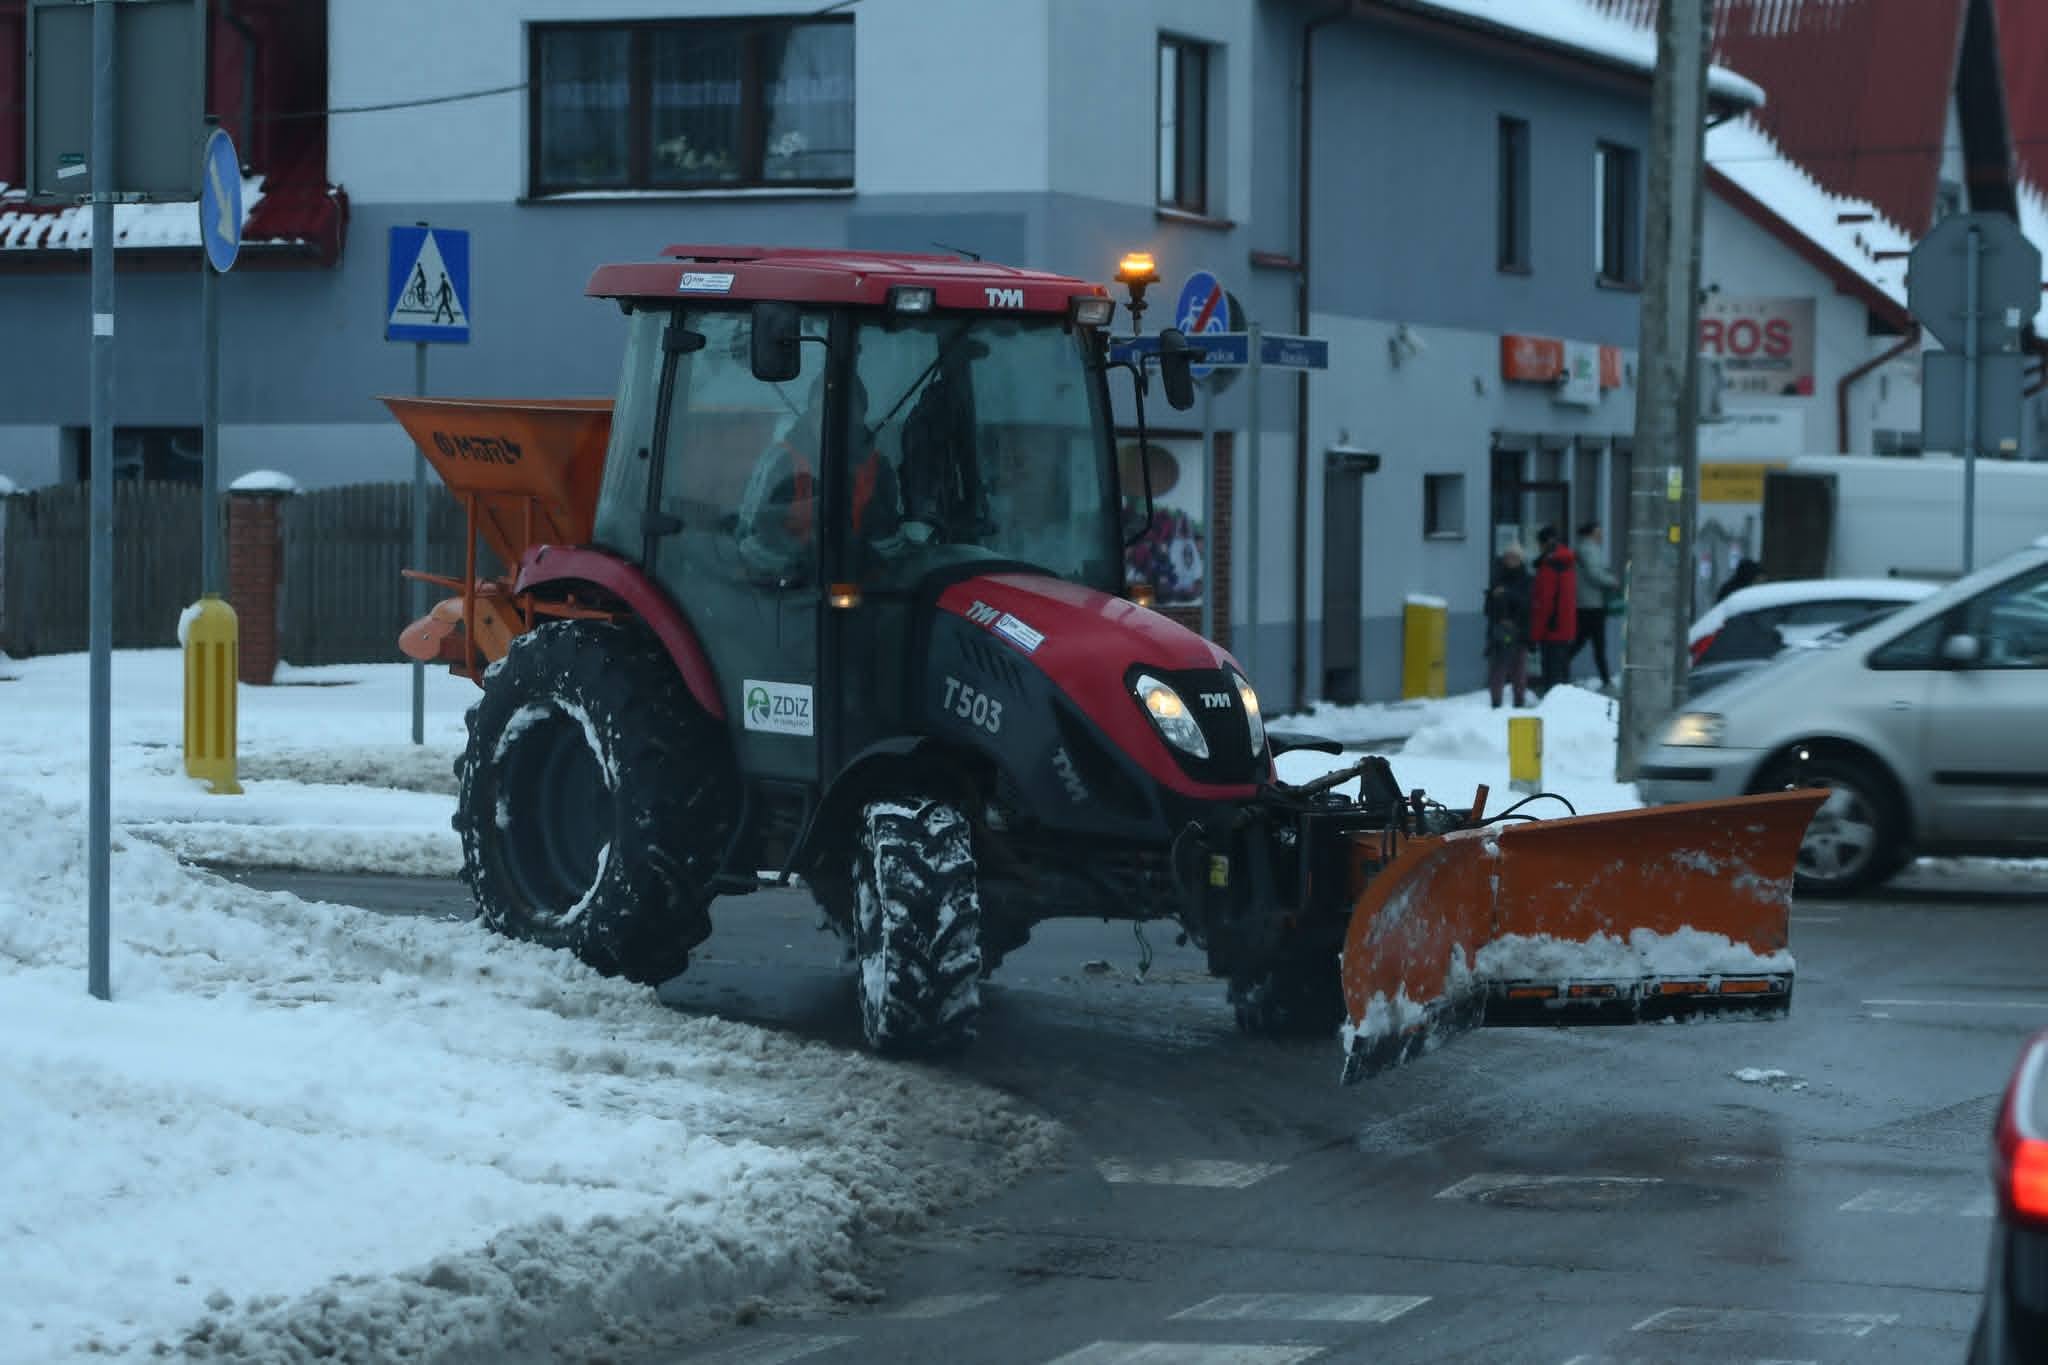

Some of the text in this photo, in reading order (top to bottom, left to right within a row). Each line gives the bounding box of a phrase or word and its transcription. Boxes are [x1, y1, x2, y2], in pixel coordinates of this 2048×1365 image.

[984, 287, 1024, 309] TYM
[964, 599, 1001, 626] TYM
[773, 695, 809, 718] ZDiZ
[1199, 692, 1232, 709] TYM
